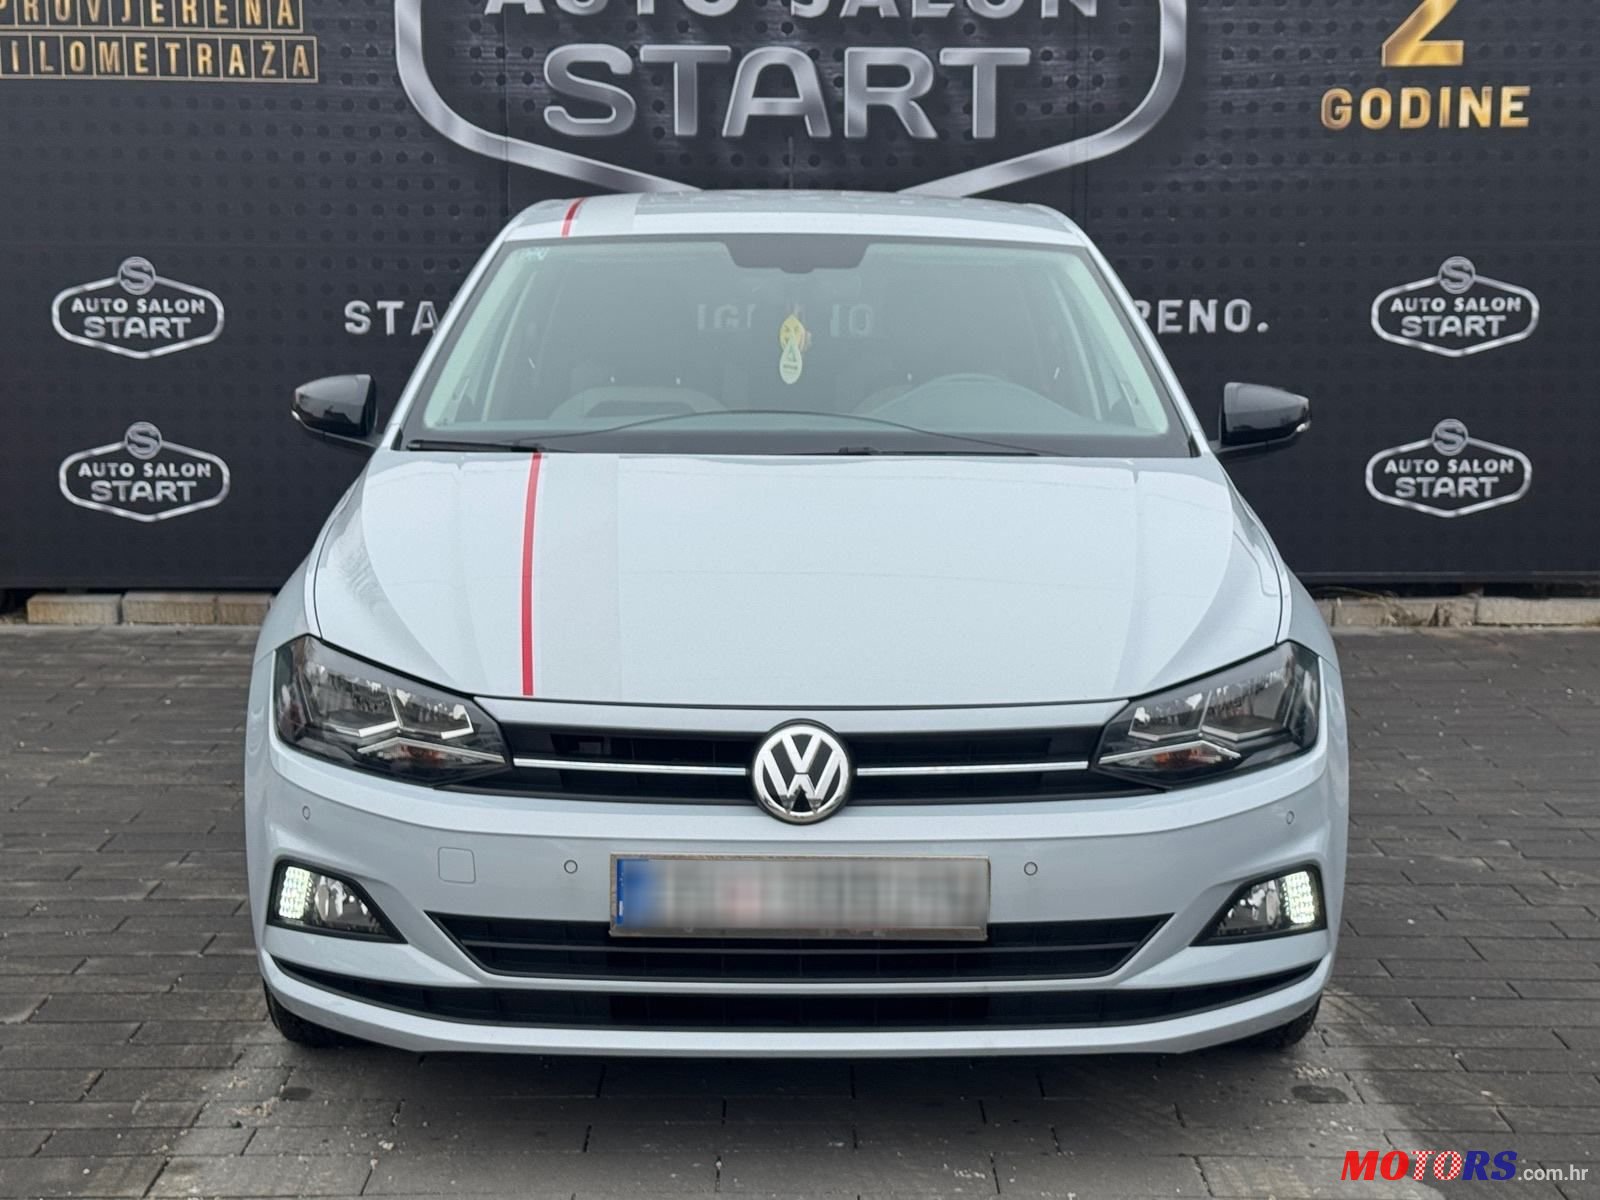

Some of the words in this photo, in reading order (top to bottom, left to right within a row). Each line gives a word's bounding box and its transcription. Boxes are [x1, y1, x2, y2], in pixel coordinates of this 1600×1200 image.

[0, 0, 294, 25] ROVJERENA
[543, 44, 1031, 138] START
[1321, 86, 1530, 129] GODINE
[71, 298, 128, 314] AUTO
[137, 298, 205, 314] SALON
[1391, 297, 1446, 312] AUTO
[1453, 297, 1521, 312] SALON
[83, 317, 192, 339] START
[344, 300, 452, 335] STA
[1400, 316, 1506, 337] START
[78, 463, 134, 478] AUTO
[143, 463, 211, 478] SALON
[1385, 459, 1439, 474] AUTO
[1447, 459, 1514, 474] SALON
[90, 481, 198, 502] START
[1395, 477, 1499, 498] START
